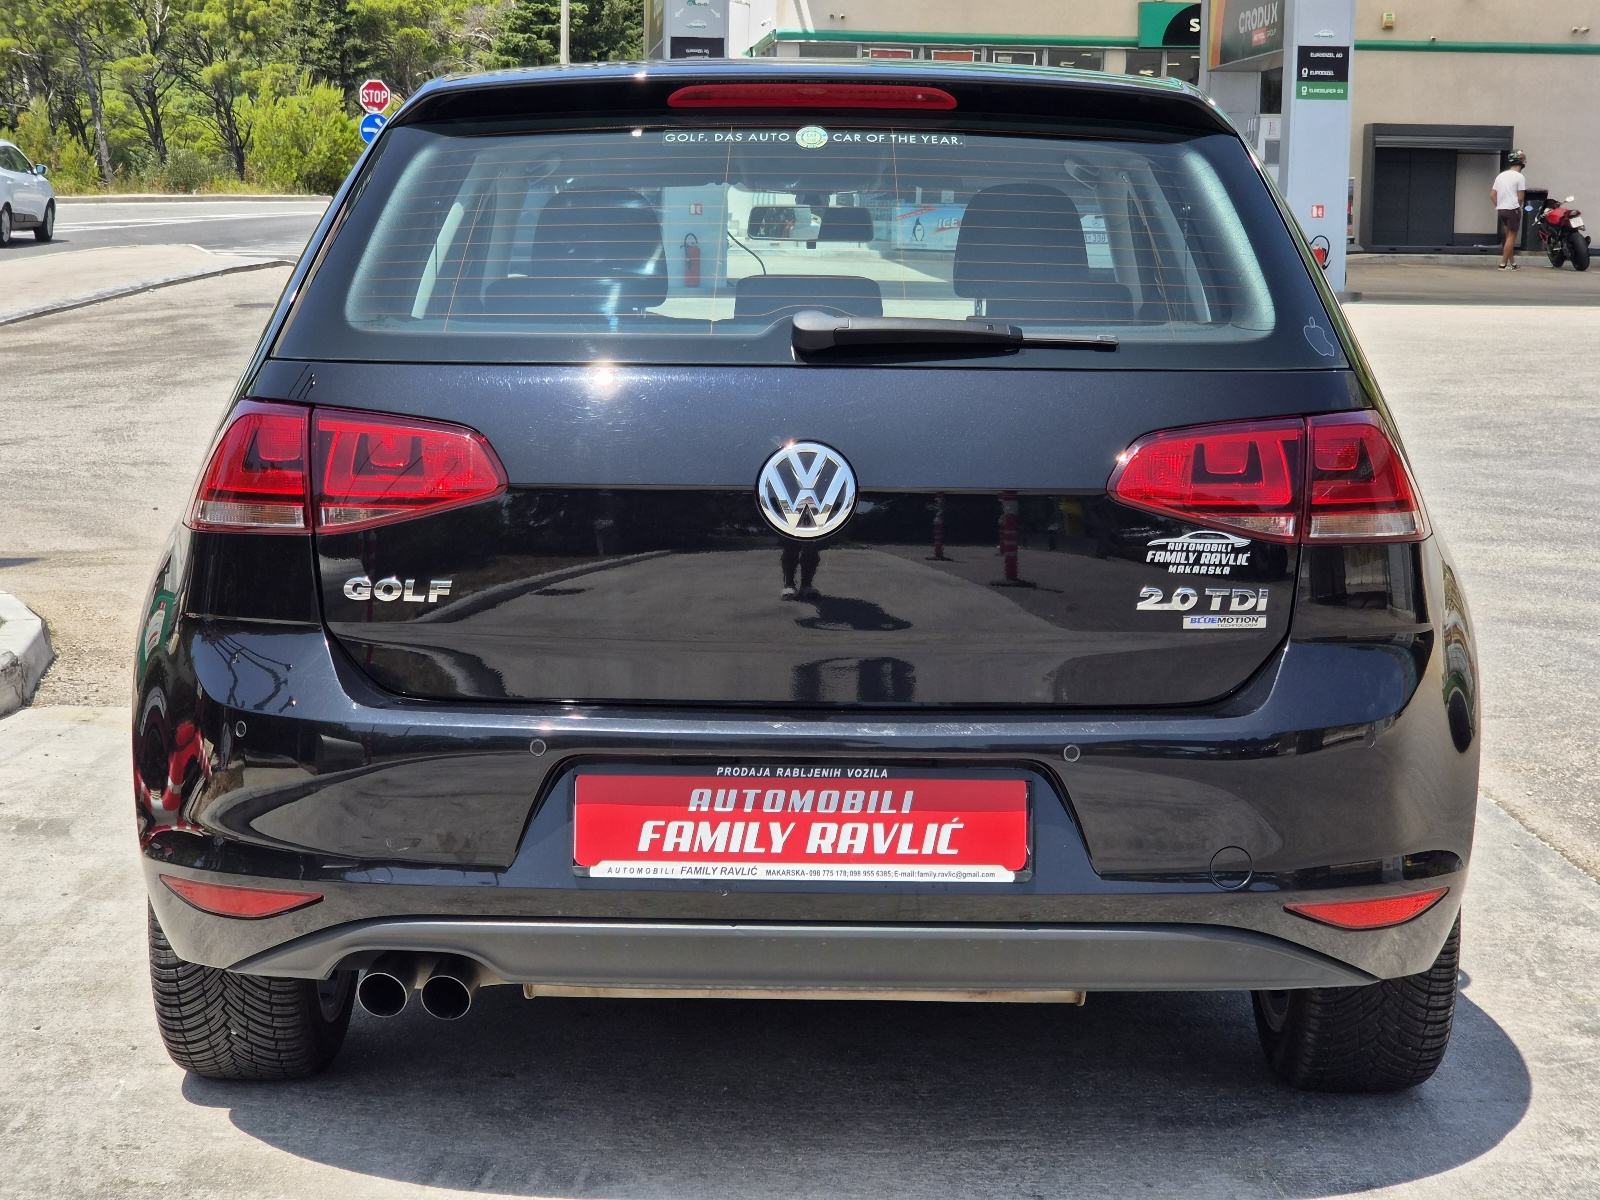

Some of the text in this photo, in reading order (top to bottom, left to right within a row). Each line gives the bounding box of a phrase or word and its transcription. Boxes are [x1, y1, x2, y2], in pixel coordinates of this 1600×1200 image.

[1238, 1, 1278, 34] CRODUX
[362, 90, 388, 103] STOP
[665, 133, 708, 142] GOLF.
[714, 133, 743, 142] DAS
[749, 133, 790, 142] AUTO
[832, 133, 861, 142] CAR
[866, 134, 886, 143] OF
[890, 134, 917, 144] THE
[921, 135, 963, 145] YEAR.
[1167, 542, 1232, 553] AUTOMOBILI
[1146, 551, 1251, 566] FAMILY RAVLIĆ
[1168, 565, 1230, 575] MAKARSKA
[343, 575, 452, 603] GOLF
[1190, 616, 1259, 624] BLUEMOTION
[716, 767, 888, 778] PRODAJA RABLJENIH VOZILA
[688, 788, 914, 814] AUTOMOBILI
[637, 817, 964, 855] FAMILY RAVLIĆ
[607, 867, 675, 875] AUTOMOBILI
[680, 866, 718, 876] FAMILY
[719, 865, 758, 877] RAVLIĆ
[862, 870, 875, 878] 955
